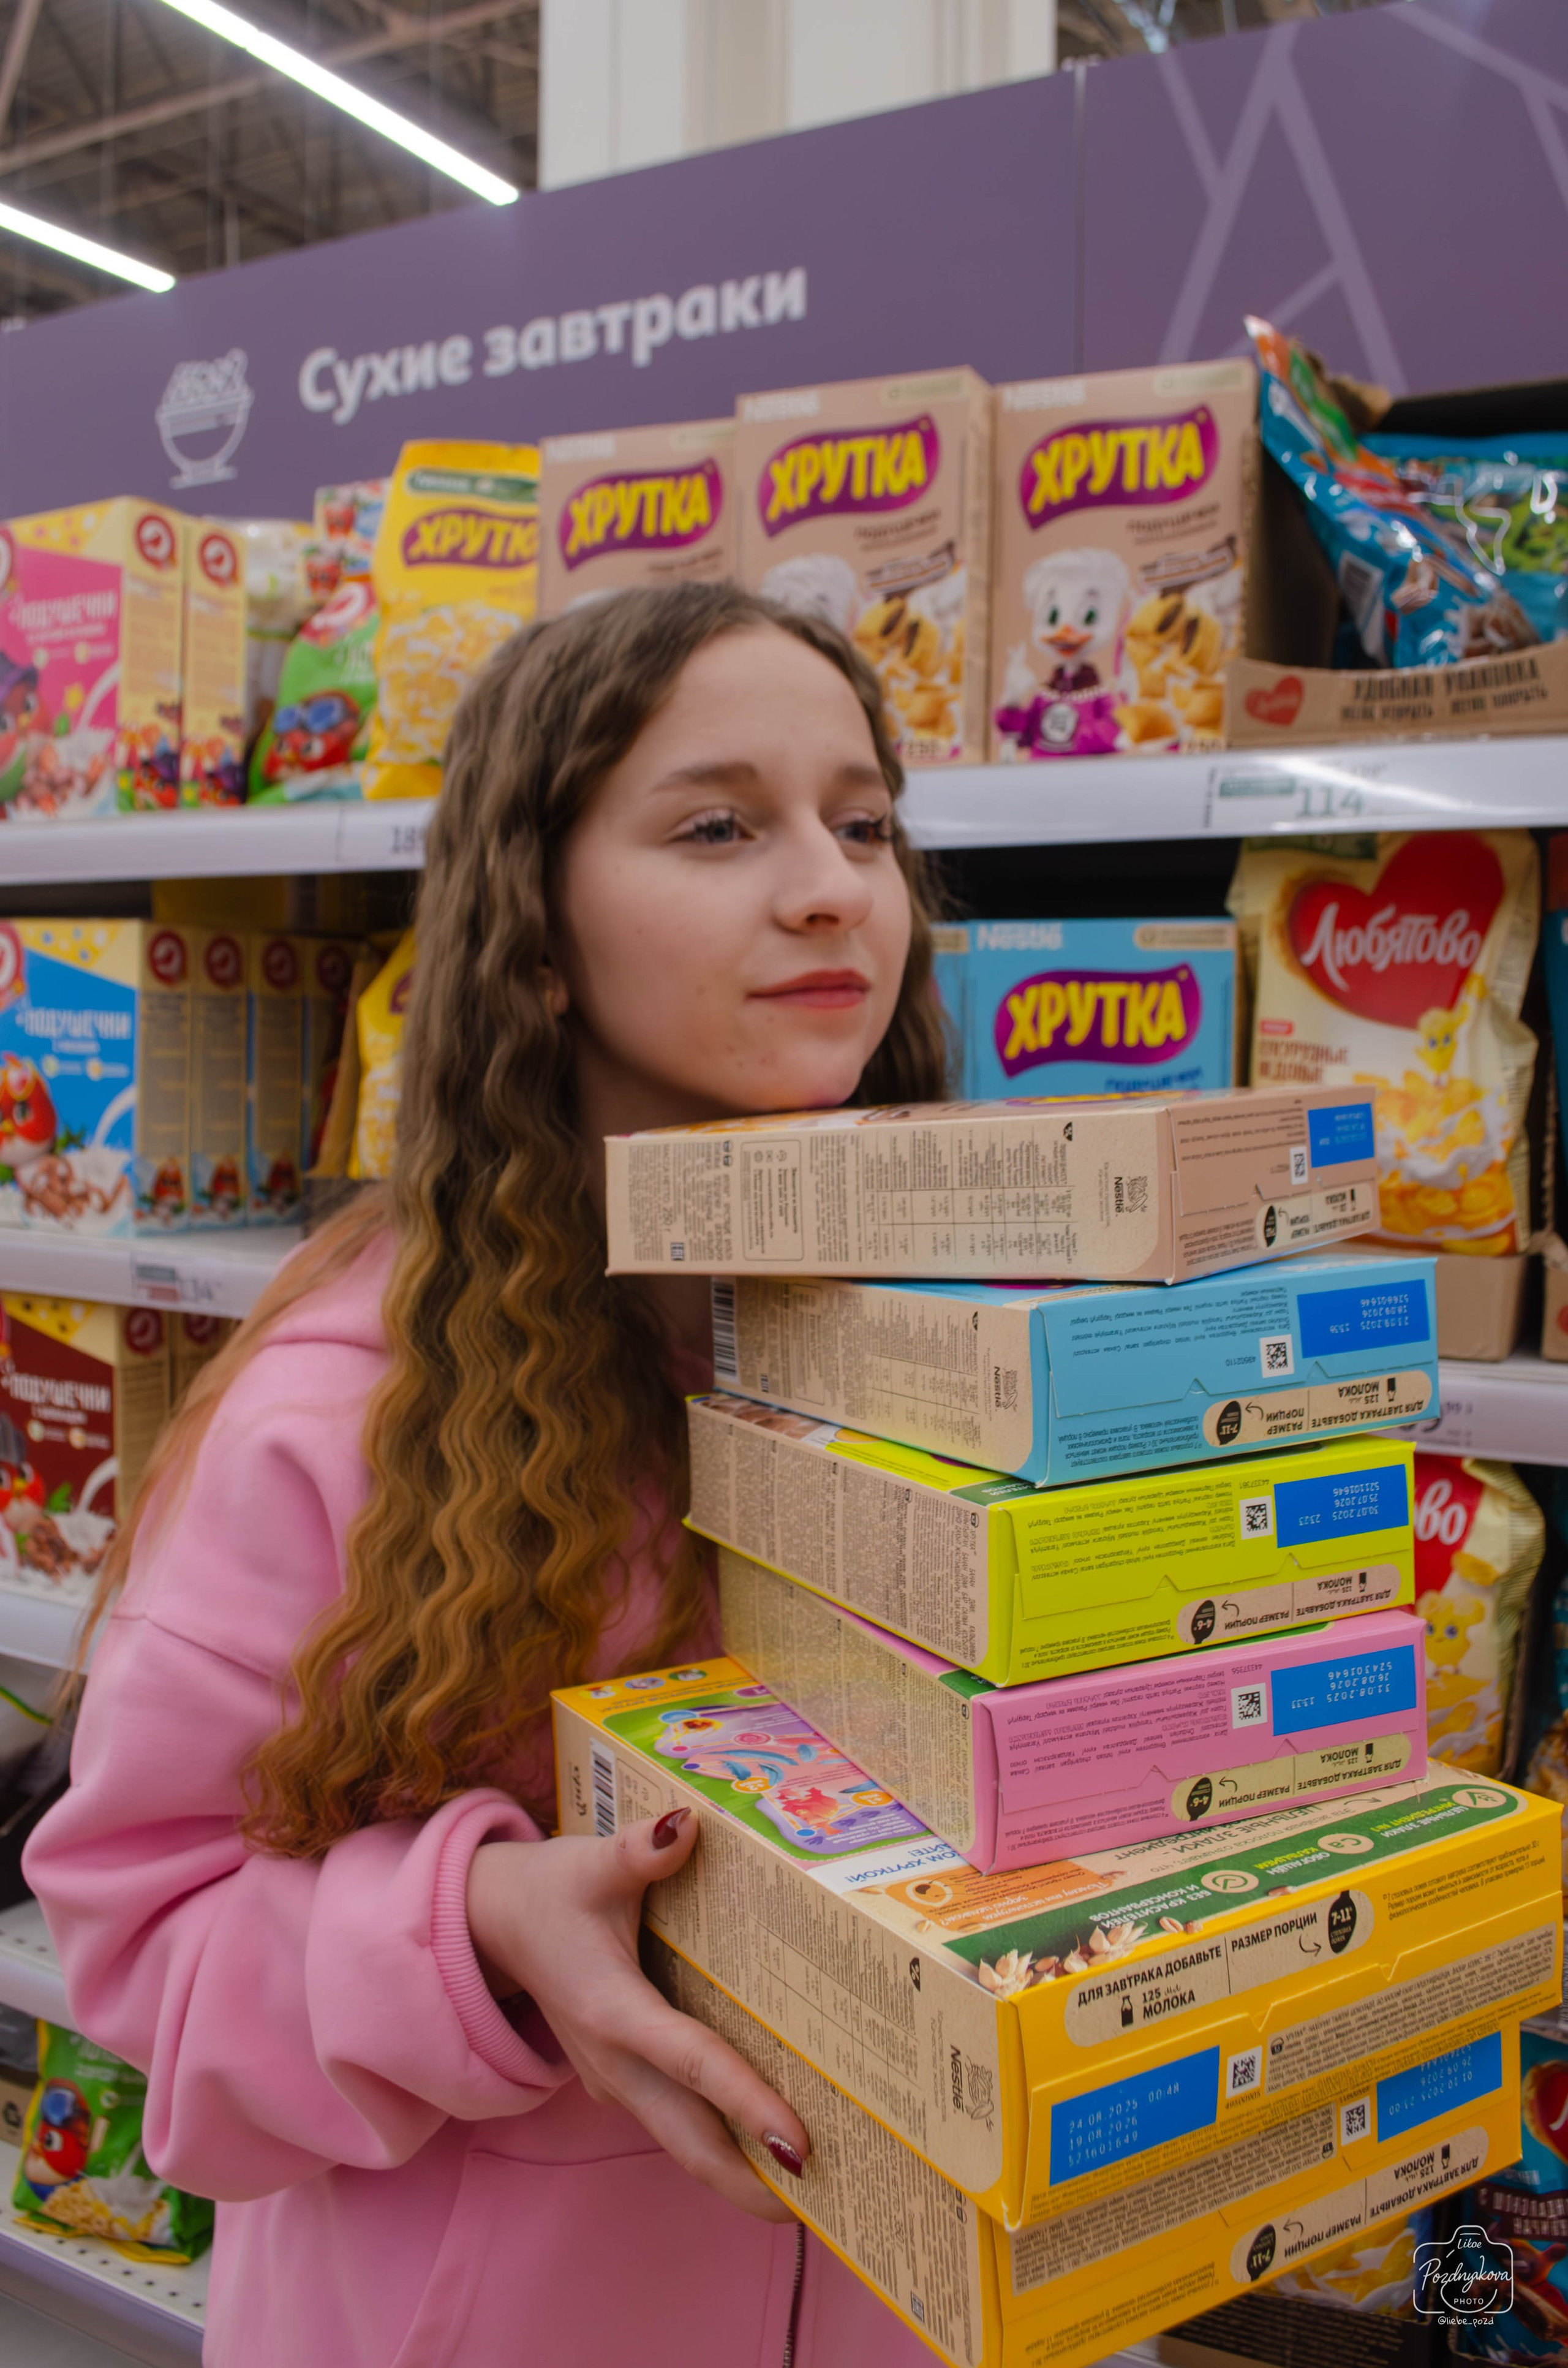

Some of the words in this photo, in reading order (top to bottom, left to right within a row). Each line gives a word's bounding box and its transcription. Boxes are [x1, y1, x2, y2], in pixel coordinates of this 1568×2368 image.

[298, 335, 473, 425] Сухие
[483, 267, 808, 377] завтраки
[767, 430, 926, 521] ХРУТКА
[1031, 423, 1204, 513] ХРУТКА
[567, 474, 712, 555] ХРУТКА
[1005, 980, 1186, 1059] ХРУТКА
[1338, 1381, 1379, 1398] МОЛОКА
[1364, 1393, 1379, 1404] 125
[1266, 1407, 1304, 1422] ПОРЦИИ
[1360, 1404, 1403, 1420] ЗАВТРАКА
[1404, 1400, 1423, 1413] ДЛЯ
[1267, 1420, 1302, 1435] РАЗМЕР
[1311, 1411, 1357, 1428] ДОБАВЬТЕ
[1316, 1575, 1352, 1591] МОЛОКА
[1336, 1593, 1373, 1608] ЗАВТРАКА
[1375, 1589, 1390, 1600] ДЛЯ
[1259, 1610, 1289, 1623] РАЗМЕР
[1295, 1600, 1335, 1616] ДОБАВЬТЕ
[1224, 1616, 1257, 1630] ПОРЦИИ
[1327, 1658, 1392, 1683] 524301646
[1320, 1746, 1359, 1764] МОЛОКА
[1384, 1758, 1401, 1771] ДЛЯ
[1296, 1772, 1341, 1790] ДОБАВЬТЕ
[1341, 1763, 1382, 1780] ЗАВТРАКА
[1218, 1791, 1255, 1808] ПОРЦИИ
[1256, 1784, 1289, 1799] РАЗМЕР
[1232, 1804, 1323, 1834] ЦЕЛЬНЫЕ
[1414, 1805, 1470, 1826] ЦЕЛЬНЫЕ
[1378, 1821, 1423, 1838] ЗЛАКИ
[1169, 1829, 1240, 1854] ЗЛАКИ
[1251, 1845, 1320, 1871] КАЛЬЦИЕМ
[843, 1858, 930, 1885] ХРУТКОЙ!
[1183, 1888, 1213, 1901] БЕЗ
[1086, 1886, 1188, 1924] КОНСЕРВАНТОВ
[1097, 1895, 1189, 1931] КРАСИТЕЛЕЙ
[1231, 1926, 1273, 1954] РАЗМЕР
[1274, 1910, 1318, 1940] ПОРЦИИ
[1077, 1984, 1103, 2009] ДЛЯ
[1105, 1963, 1163, 1999] ЗАВТРАКА
[1164, 1943, 1221, 1980] ДОБАВЬТЕ
[1142, 1986, 1161, 2005] 125
[1143, 1987, 1196, 2020] МОЛОКА
[950, 2043, 963, 2115] Nestlé
[1393, 2150, 1434, 2181] МОЛОКА
[1420, 2163, 1434, 2177] 125
[1460, 2155, 1478, 2174] ДЛЯ
[1415, 2165, 1458, 2195] ЗАВТРАКА
[1368, 2185, 1415, 2219] ДОБАВЬТЕ
[1325, 2211, 1361, 2239] РАЗМЕР
[1283, 2228, 1324, 2259] ПОРЦИИ
